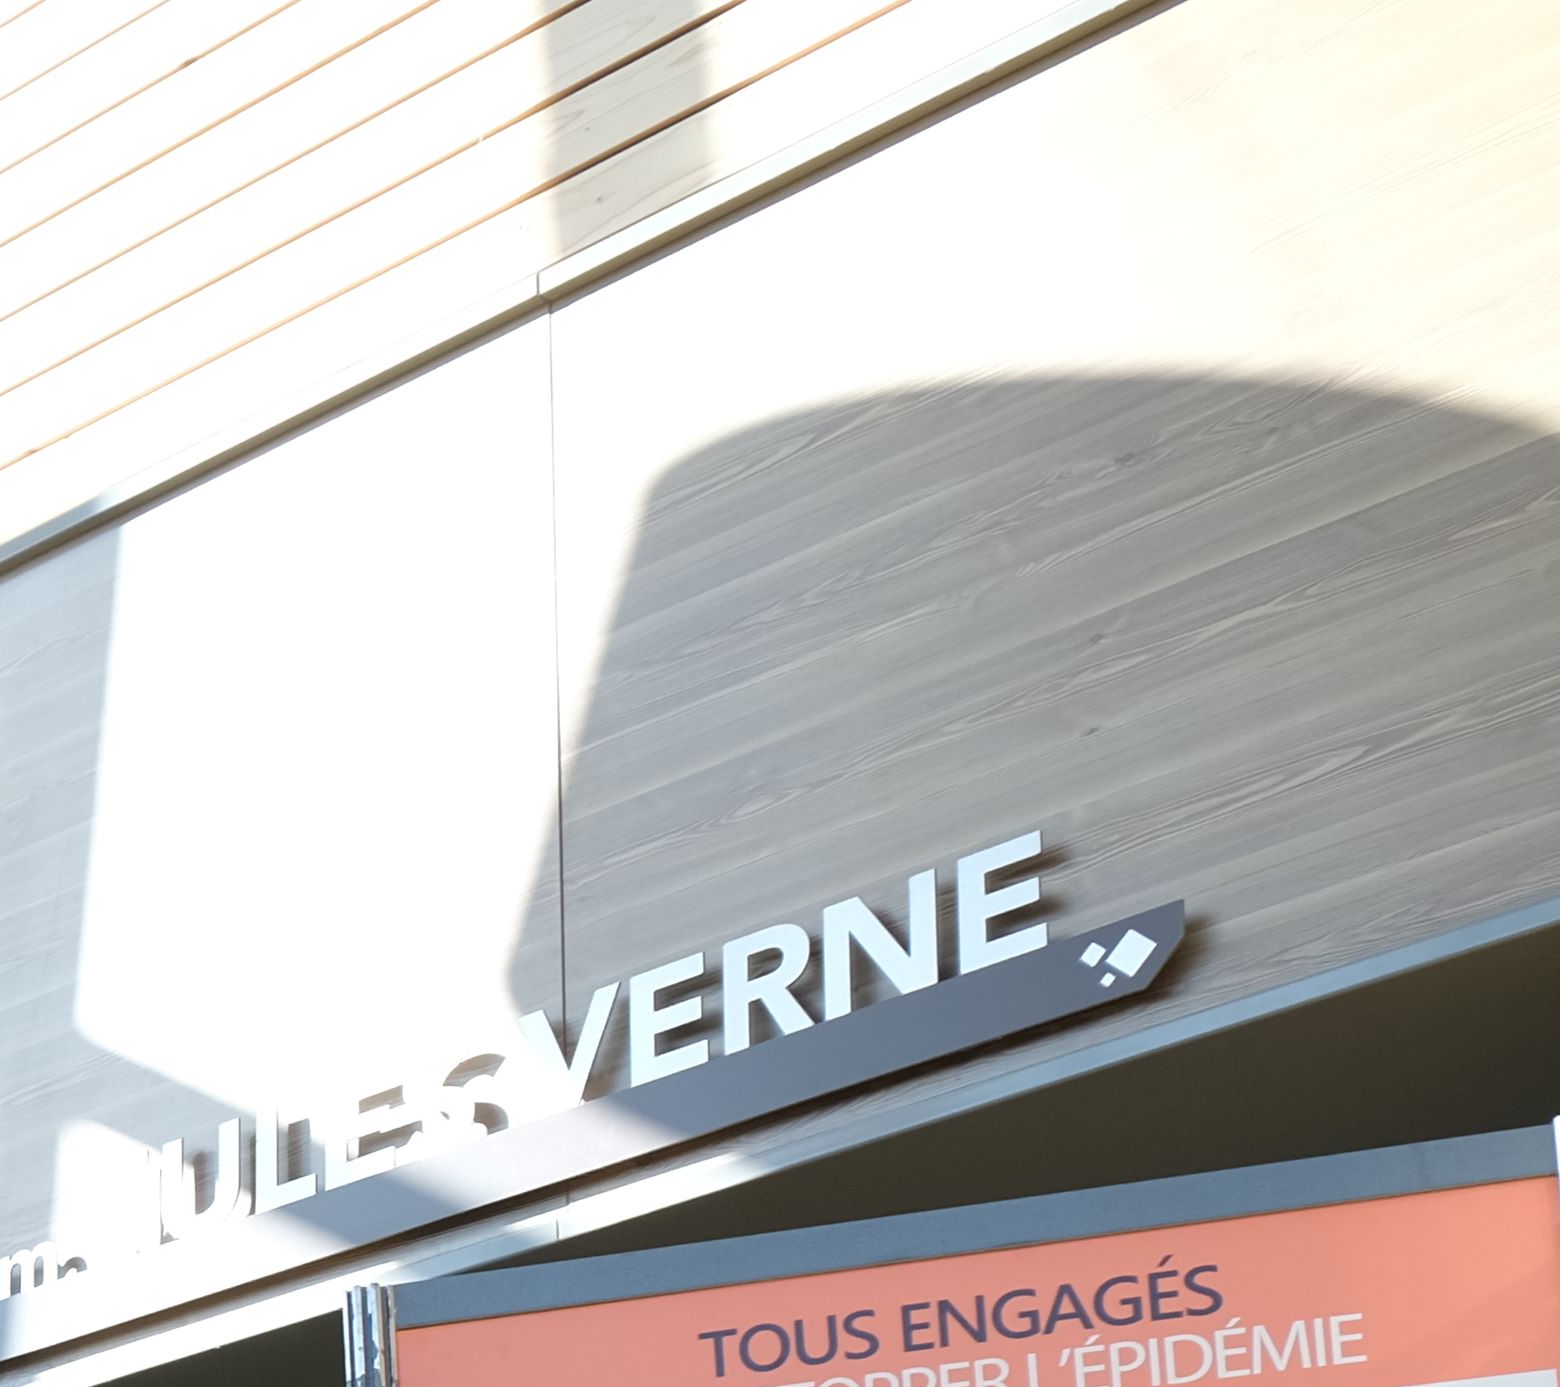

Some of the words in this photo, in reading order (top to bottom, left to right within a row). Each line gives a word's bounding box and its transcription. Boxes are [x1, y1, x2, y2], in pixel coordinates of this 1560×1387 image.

[519, 829, 1049, 1106] VERNE
[699, 1309, 880, 1378] TOUS
[901, 1254, 1223, 1354] ENGAGÉS
